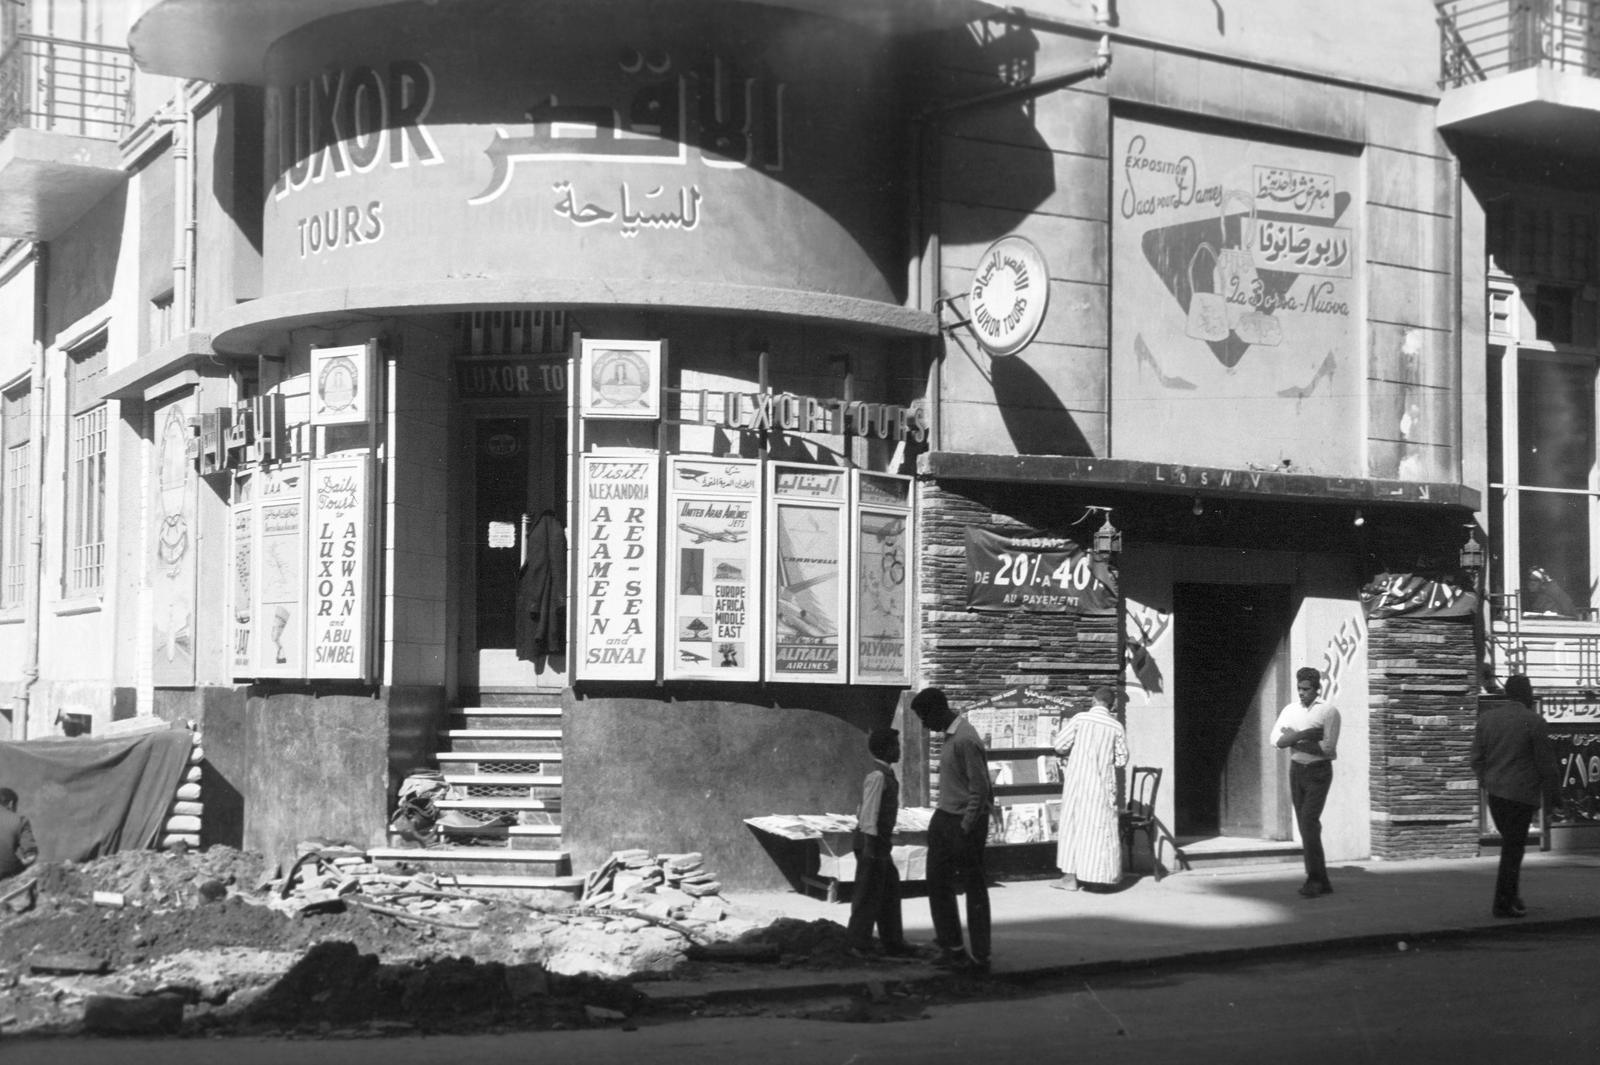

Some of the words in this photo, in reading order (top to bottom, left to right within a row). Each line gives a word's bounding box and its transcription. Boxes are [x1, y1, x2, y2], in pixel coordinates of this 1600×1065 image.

[272, 58, 442, 200] LUXOR
[1125, 155, 1188, 176] EXPOSITION
[297, 199, 385, 258] TOURS
[1002, 297, 1027, 335] TOURS
[702, 388, 819, 432] LUXOR
[830, 398, 926, 443] TOURS
[588, 483, 649, 501] ALEXANDRIA
[680, 502, 705, 518] UNITED
[704, 503, 723, 519] ARAB
[727, 519, 746, 528] JETS
[782, 556, 838, 565] CARAVELLE
[317, 522, 335, 617] LUXOR
[339, 521, 358, 617] ASWAN
[588, 506, 613, 636] ALAMEIN
[974, 571, 991, 584] DE
[715, 584, 746, 598] EUROPE
[715, 599, 745, 612] AFRICA
[1003, 593, 1017, 604] AU
[1023, 594, 1080, 606] PAYEMENT
[714, 612, 746, 626] MIDDLE
[322, 629, 352, 644] ABU
[718, 625, 742, 639] EAST
[605, 635, 633, 646] and
[314, 646, 355, 665] SIMBEL
[586, 647, 647, 665] SINAI
[776, 647, 839, 661] ALITALIA
[860, 641, 904, 657] OLYMPIC
[784, 661, 829, 671] AIRLINES
